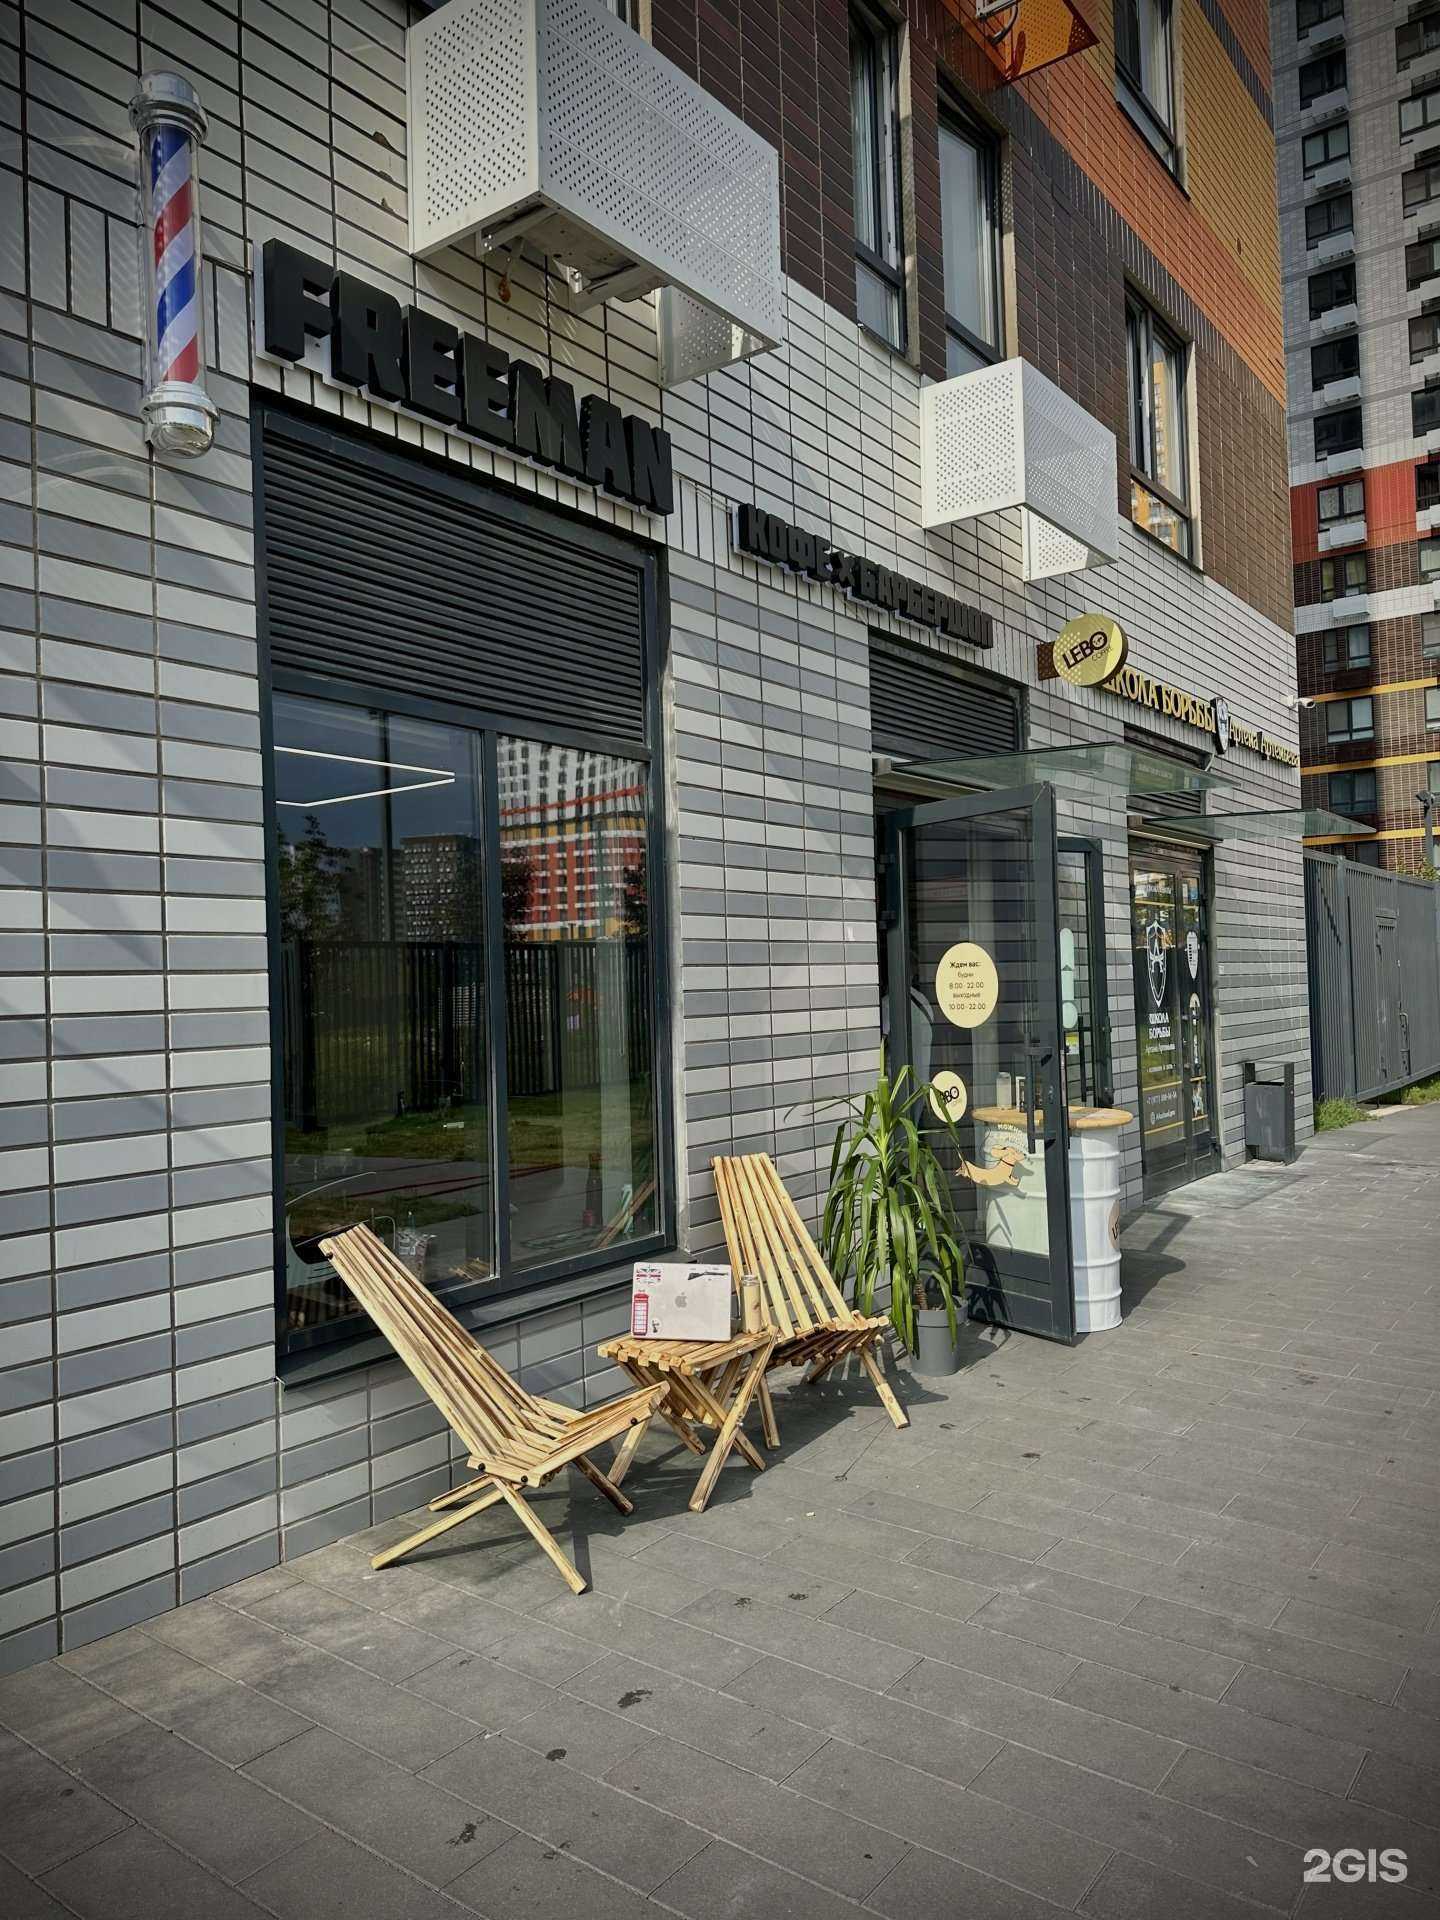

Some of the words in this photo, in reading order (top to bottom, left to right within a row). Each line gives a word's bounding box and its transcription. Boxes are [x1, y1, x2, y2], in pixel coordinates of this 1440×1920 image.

[262, 237, 674, 516] FREEMAN
[738, 502, 831, 582] КОФЕ
[851, 555, 993, 650] БАРБЕРШОП
[1062, 631, 1108, 669] LEBO
[1162, 685, 1217, 734] БОРЬБЫ
[1149, 1012, 1170, 1025] ШКОЛА
